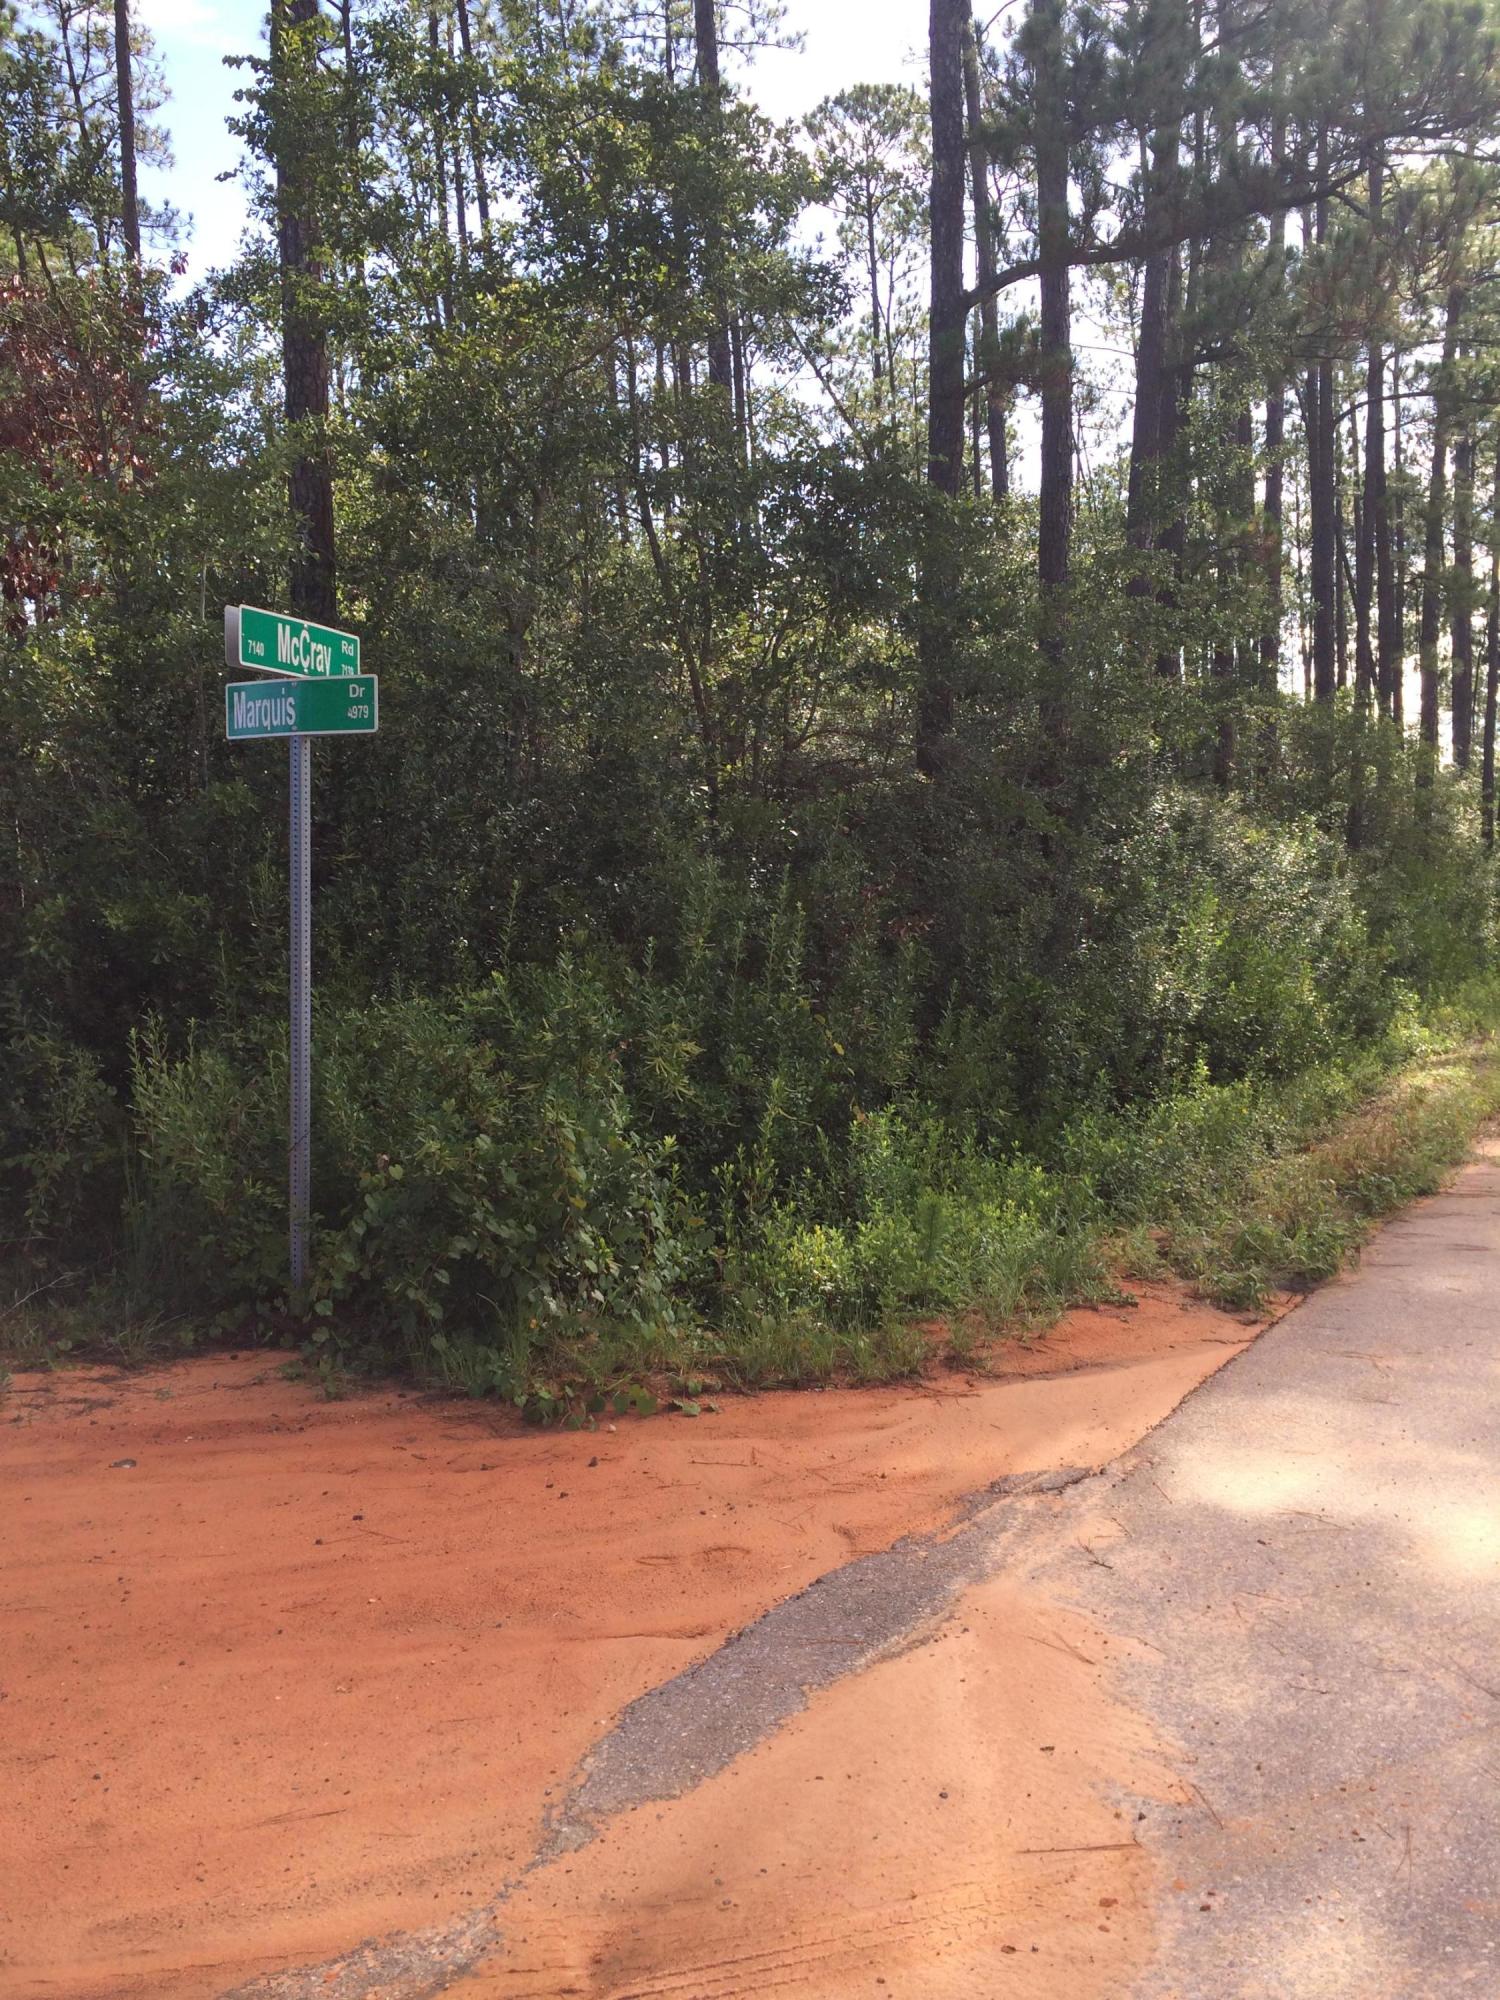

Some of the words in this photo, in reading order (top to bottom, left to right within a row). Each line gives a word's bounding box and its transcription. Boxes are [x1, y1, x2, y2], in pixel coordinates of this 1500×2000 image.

[248, 639, 264, 657] 7140
[277, 622, 331, 676] McCray
[341, 640, 354, 657] Rd
[233, 687, 296, 731] Marquis
[349, 684, 366, 698] Dr
